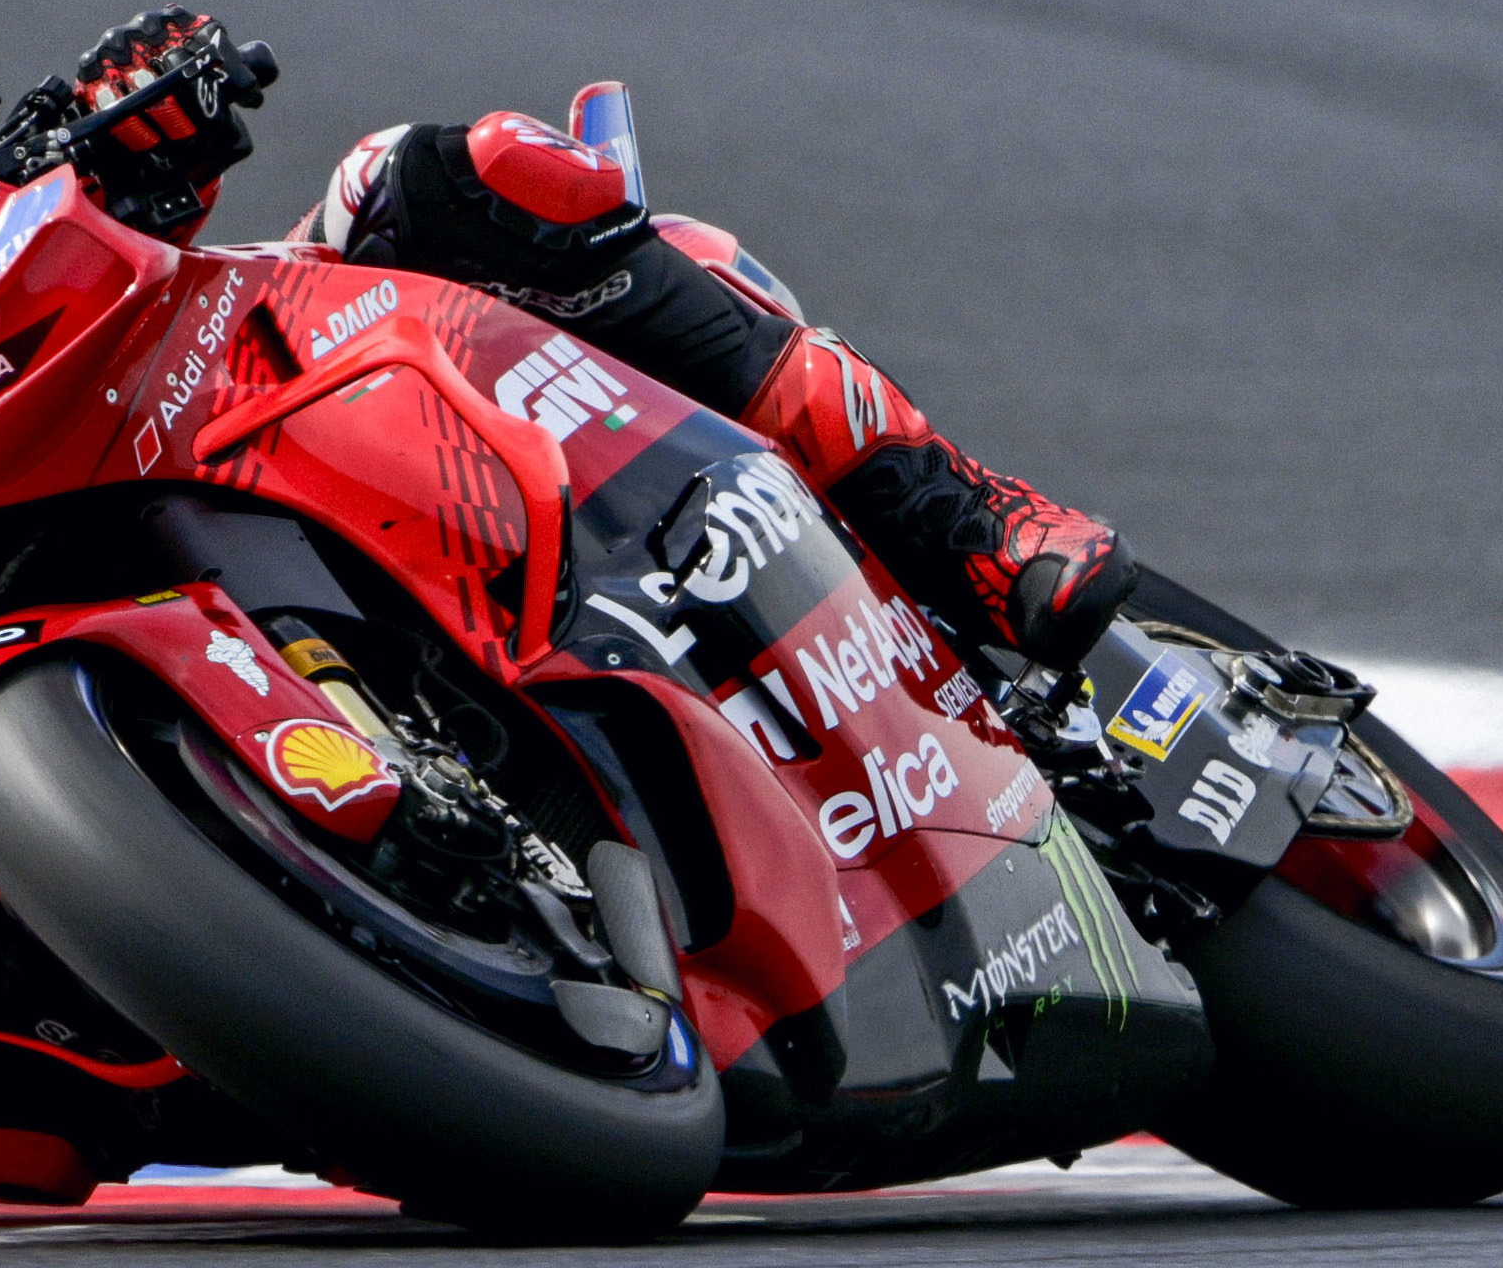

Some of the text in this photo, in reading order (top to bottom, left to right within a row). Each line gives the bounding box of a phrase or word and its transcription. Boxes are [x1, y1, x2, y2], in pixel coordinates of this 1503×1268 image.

[159, 267, 243, 430] Audi Sport
[327, 279, 397, 346] DAIKO
[796, 595, 940, 730] NetApp
[819, 733, 960, 859] elica
[941, 901, 1079, 1021] MONSTER
